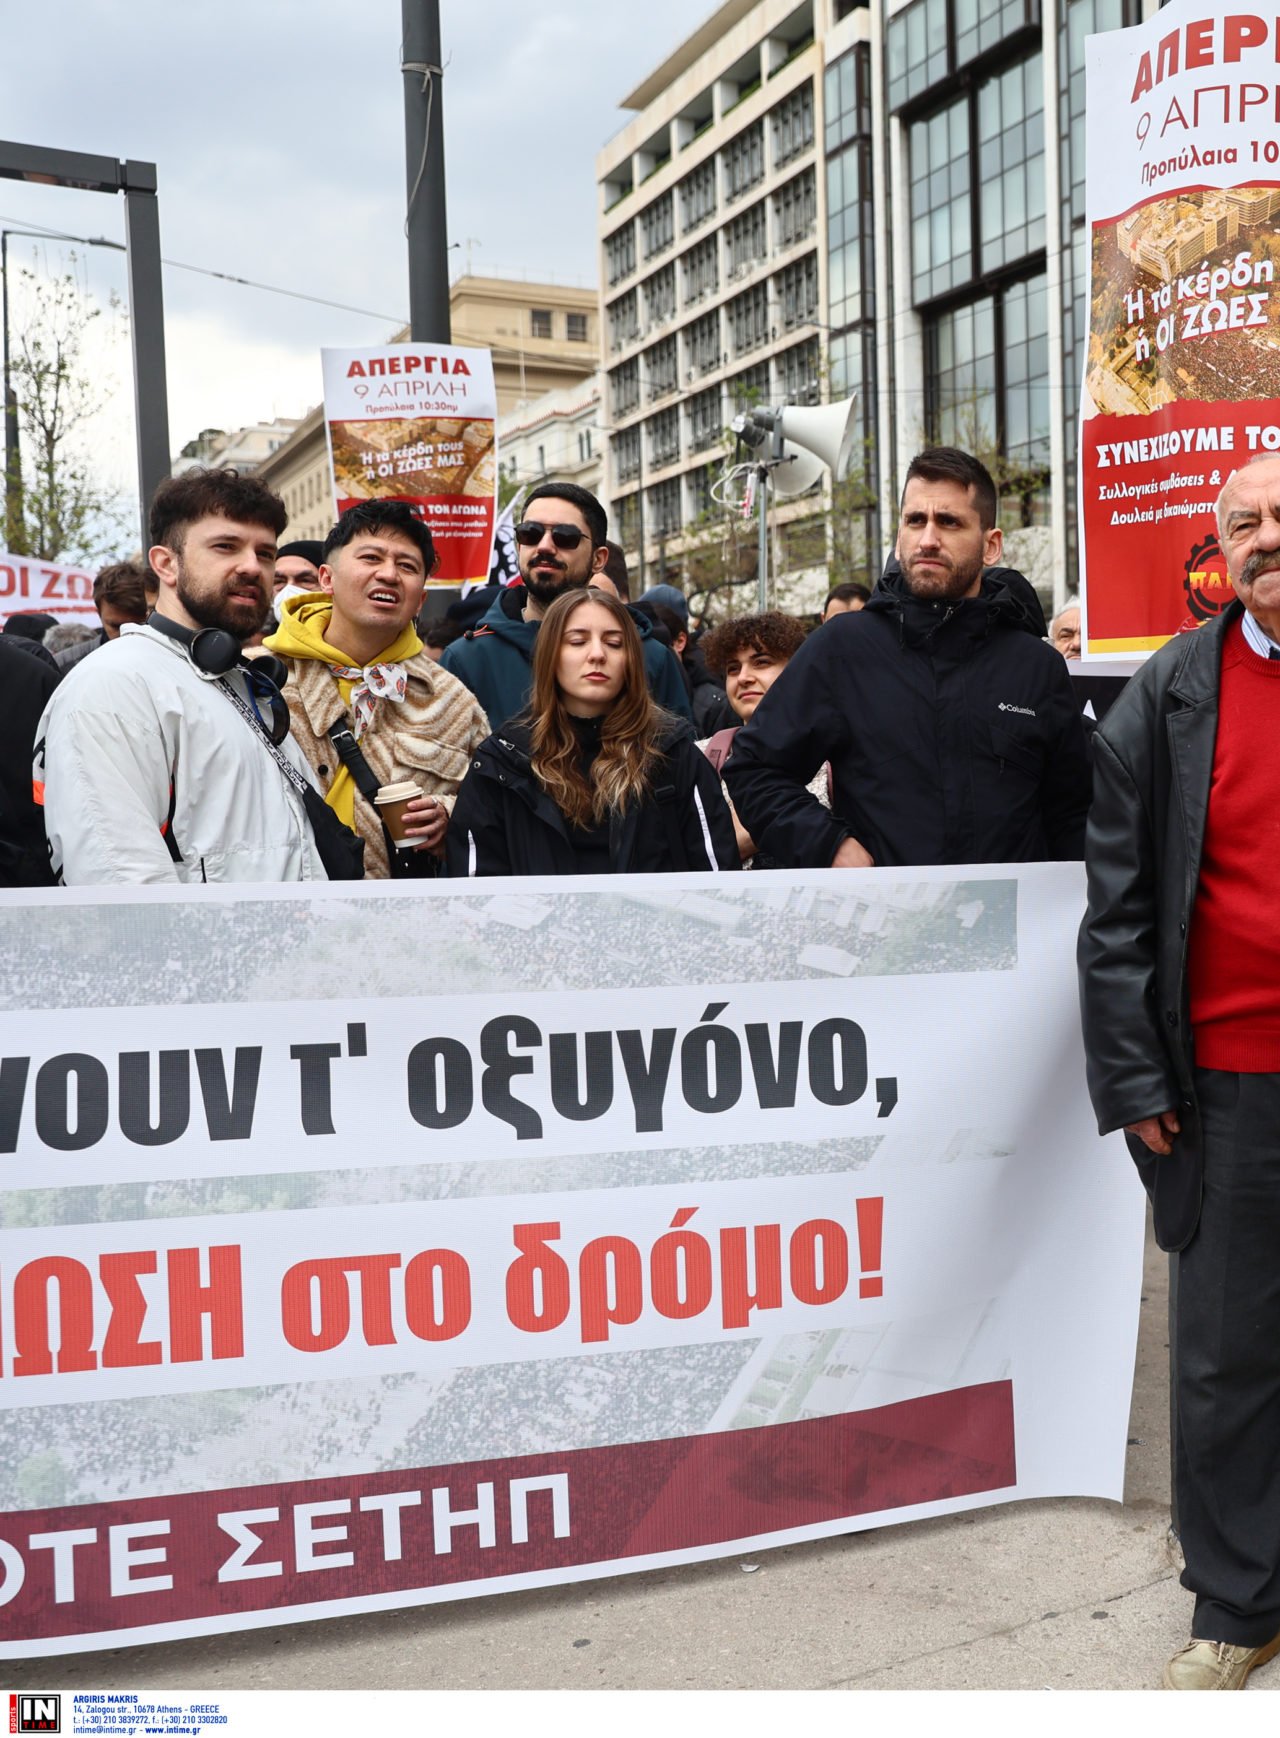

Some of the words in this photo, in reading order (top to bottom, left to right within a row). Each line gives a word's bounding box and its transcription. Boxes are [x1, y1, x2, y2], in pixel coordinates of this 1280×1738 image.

[1136, 112, 1151, 151] 9
[1142, 144, 1238, 187] Προπύλαια
[1151, 285, 1171, 314] τα
[1177, 251, 1274, 301] κέρδη
[1135, 327, 1150, 363] ή
[1156, 313, 1176, 352] ΟΙ
[1181, 292, 1269, 340] ΖΩΕΣ
[347, 356, 471, 378] ΑΠΕΡΓΙΑ
[354, 384, 369, 399] 9
[378, 381, 467, 398] ΑΠΡΙΛΗ
[397, 456, 433, 473] ΖΩΕΣ
[437, 453, 465, 467] ΜΑΣ
[1096, 426, 1234, 468] ΣΥΝΕΧΙΖΟΥΜΕ
[1098, 479, 1159, 500] Συλλογικές
[1209, 469, 1221, 485] &
[428, 504, 450, 515] ΤΟΝ
[452, 504, 487, 515] ΑΓΩΝΑ
[1110, 506, 1154, 526] Δουλειά
[40, 569, 94, 600] ΖΩ
[407, 1001, 898, 1141] οξυγόνο,
[0, 1244, 245, 1378] ΩΣΗ
[281, 1247, 472, 1353] στο
[505, 1196, 884, 1344] δρόμο!
[217, 1473, 571, 1583] ΣΕΤΗΠ
